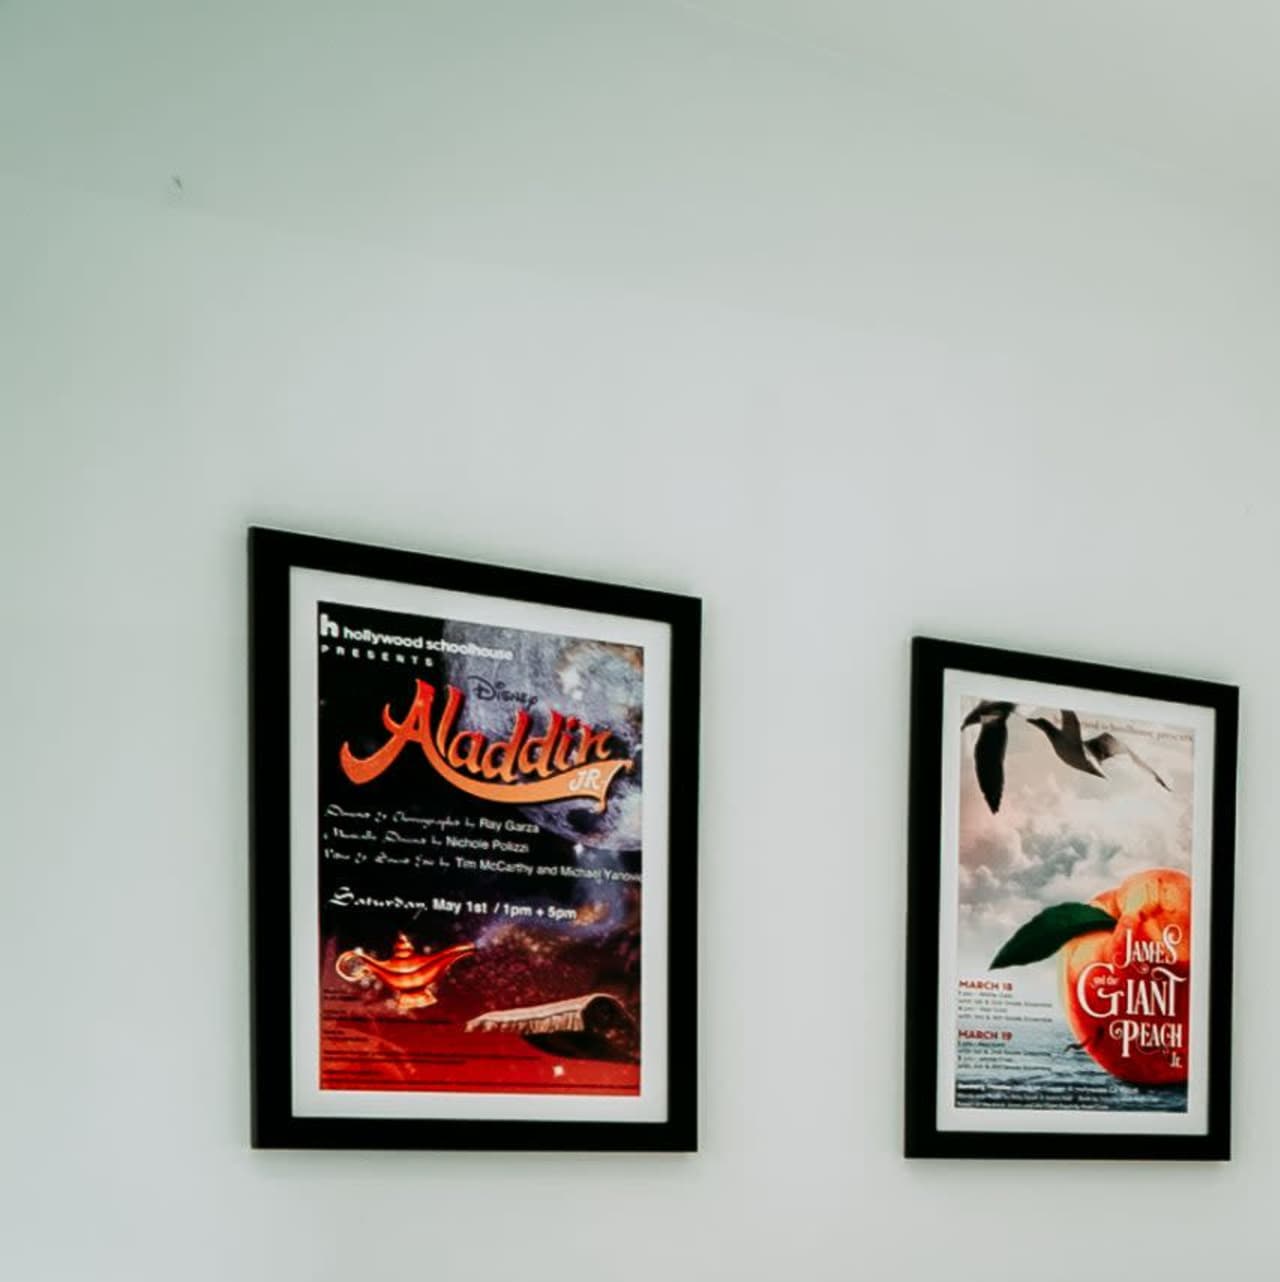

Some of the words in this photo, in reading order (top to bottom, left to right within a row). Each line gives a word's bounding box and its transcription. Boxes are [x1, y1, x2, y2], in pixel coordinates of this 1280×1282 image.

[343, 626, 423, 649] hollywood
[425, 640, 514, 661] schoolhouse
[321, 644, 434, 667] PRESENTS
[467, 675, 539, 710] Disney
[339, 678, 632, 806] Aladdin
[480, 818, 501, 832] Ray
[504, 820, 541, 833] Garza
[446, 836, 489, 851] Nichole
[456, 857, 476, 869] Tim
[480, 860, 533, 876] McCarthy
[536, 865, 558, 875] and
[432, 898, 462, 915] May
[466, 900, 488, 914] 1st
[503, 903, 533, 918] 1pm
[548, 906, 577, 920] 5pm
[1112, 923, 1183, 969] JAMES
[959, 980, 999, 991] MARCH
[1076, 961, 1187, 1019] GIANT
[959, 1030, 998, 1040] MARCH
[1108, 1019, 1183, 1058] PEACH
